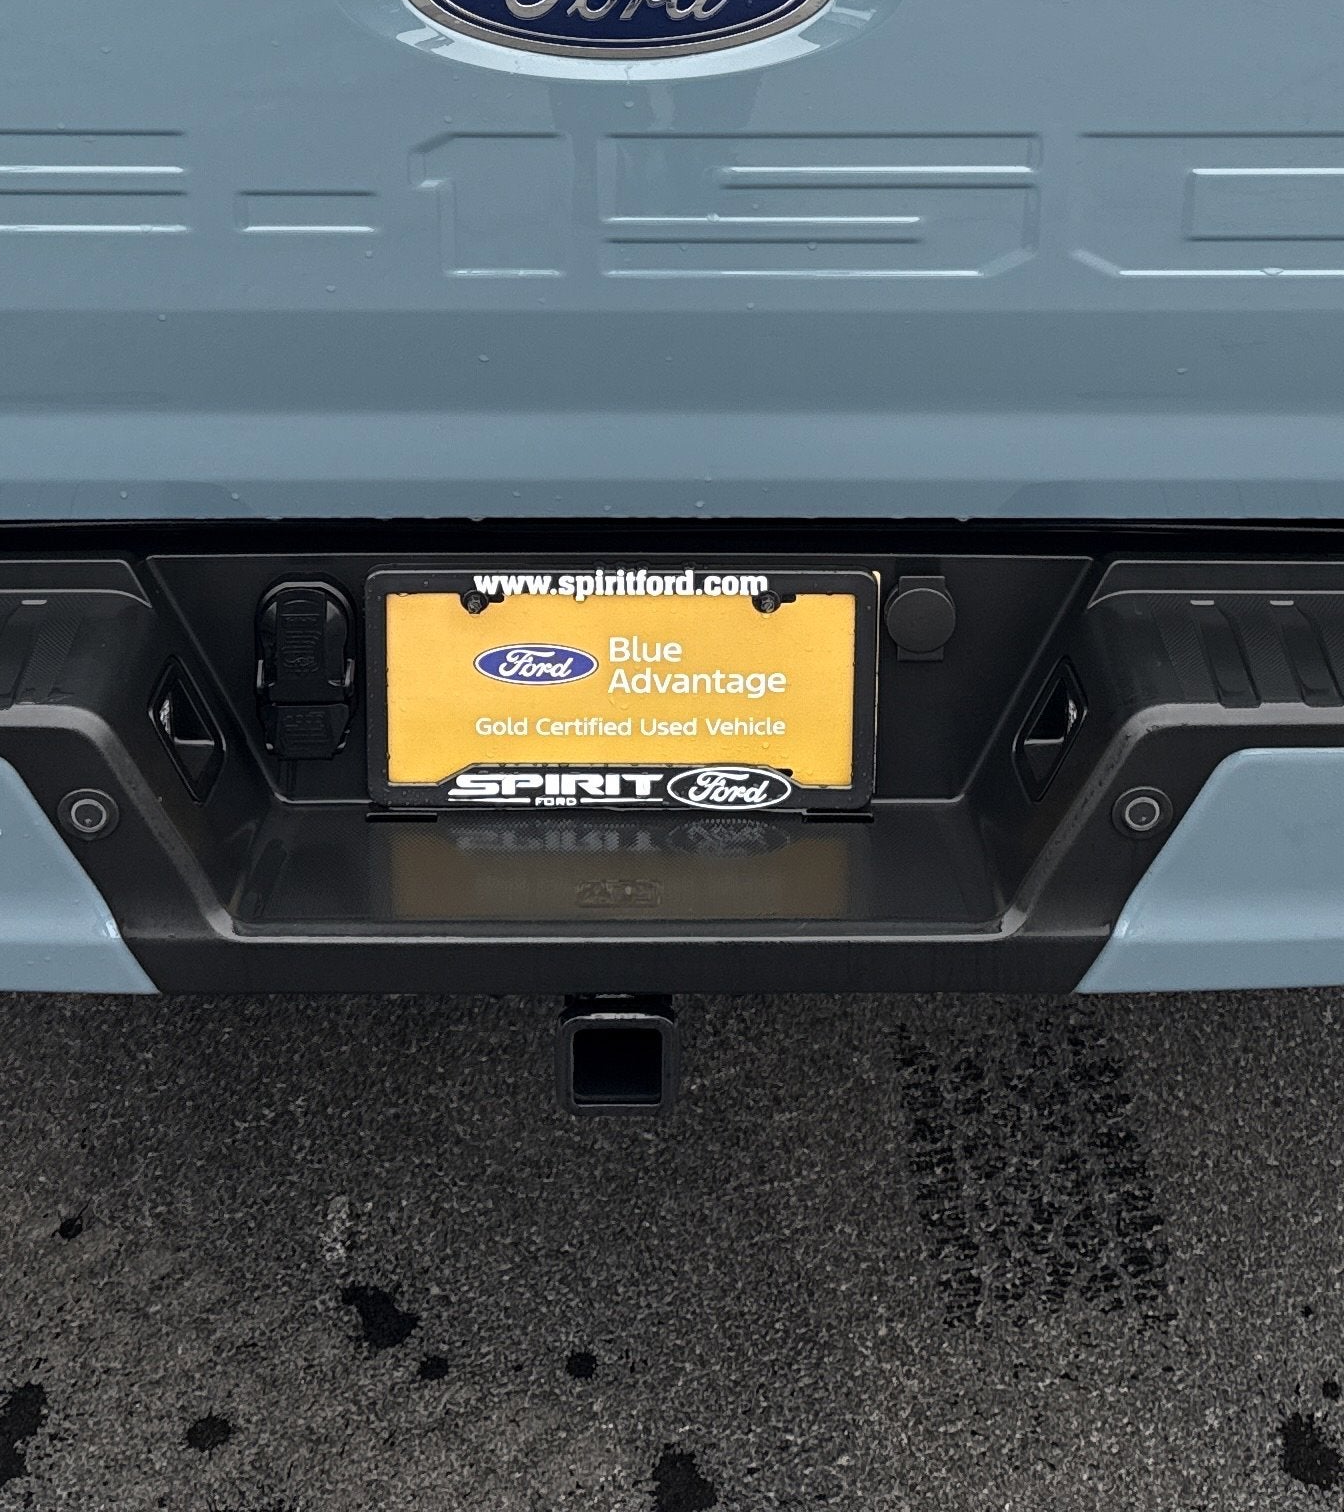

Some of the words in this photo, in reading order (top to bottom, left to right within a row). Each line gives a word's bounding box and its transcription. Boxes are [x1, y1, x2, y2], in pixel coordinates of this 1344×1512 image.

[473, 569, 768, 600] www.spiritford.com
[609, 636, 682, 663] Blue
[498, 649, 574, 679] Ford
[608, 667, 787, 698] Advantage
[475, 717, 528, 736] Gold
[536, 717, 632, 736] Certified
[641, 717, 698, 736] Used
[705, 717, 786, 736] Vehicle
[448, 773, 664, 796] SPIRIT
[688, 773, 769, 804] Ford
[535, 797, 578, 806] FORD
